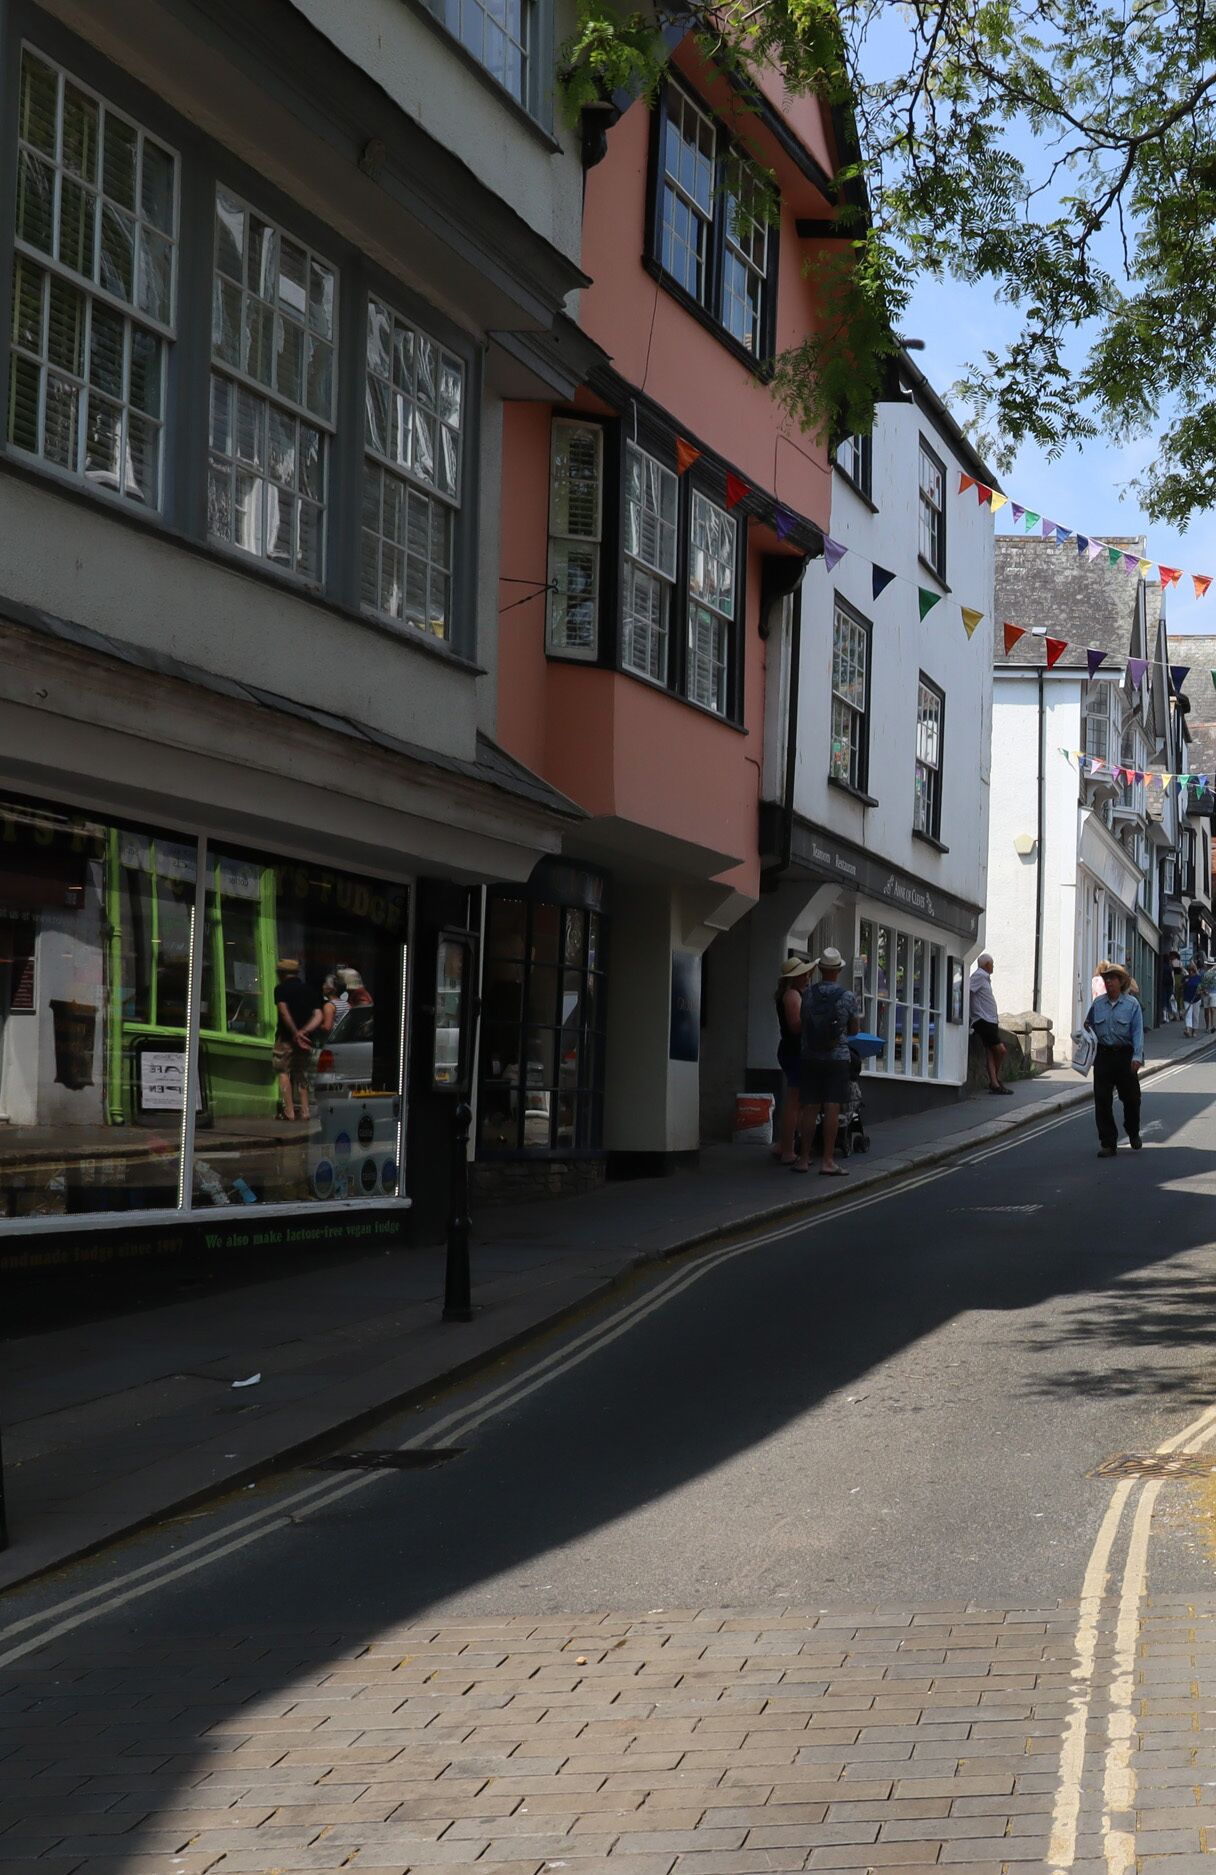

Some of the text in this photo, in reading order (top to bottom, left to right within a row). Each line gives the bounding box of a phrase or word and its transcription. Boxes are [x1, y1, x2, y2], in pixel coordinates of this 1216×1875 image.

[205, 1220, 400, 1248] We also make lactose-free vegan fudge
